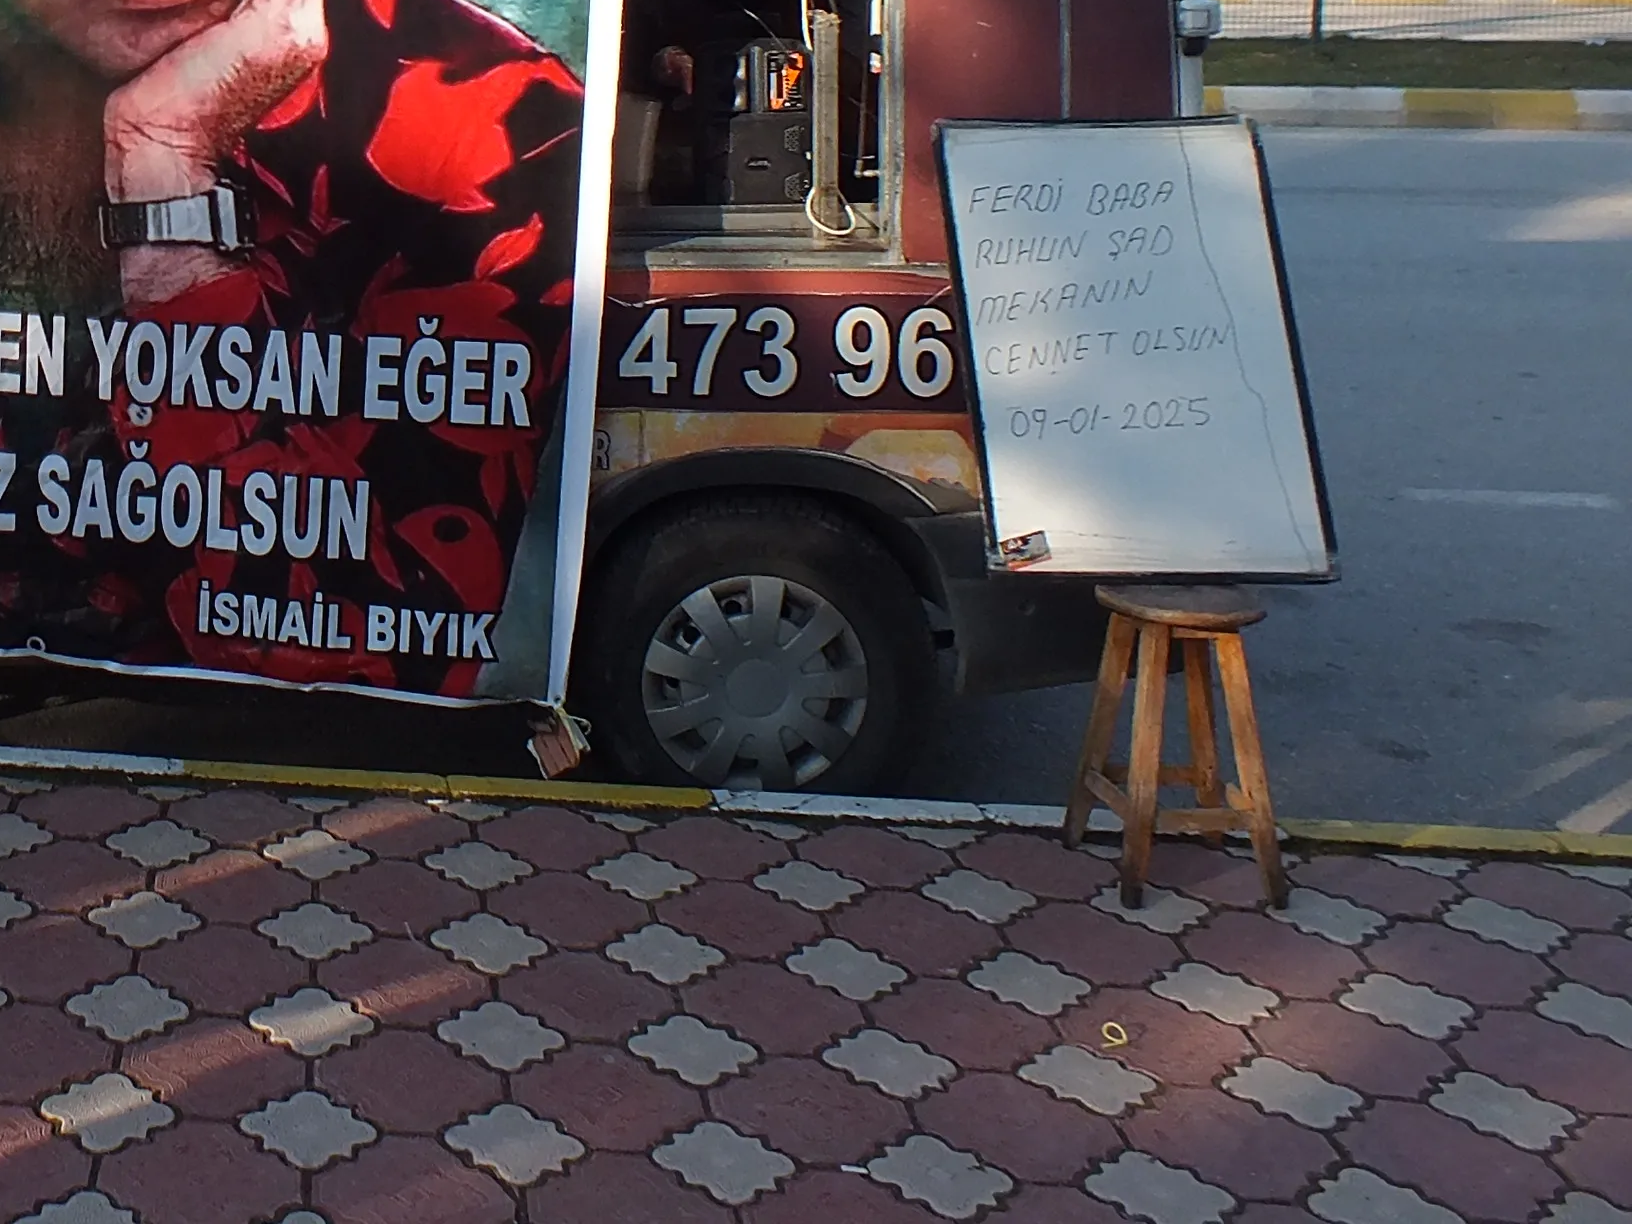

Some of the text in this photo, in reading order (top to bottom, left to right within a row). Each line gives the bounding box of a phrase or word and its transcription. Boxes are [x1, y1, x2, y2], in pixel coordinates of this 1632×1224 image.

[968, 178, 1175, 216] FERDİ BABA
[974, 229, 1088, 268] RUHUN
[975, 270, 1153, 326] MEKANIN
[86, 317, 342, 417] YOKSAN
[364, 316, 532, 427] EĞER
[619, 306, 954, 398] 473 96
[984, 325, 1231, 376] CENNET OLSUN
[1008, 397, 1211, 440] 09-01-2025
[36, 439, 370, 560] SAĞOLSUN
[197, 579, 497, 660] İSMAİL BIYIK
